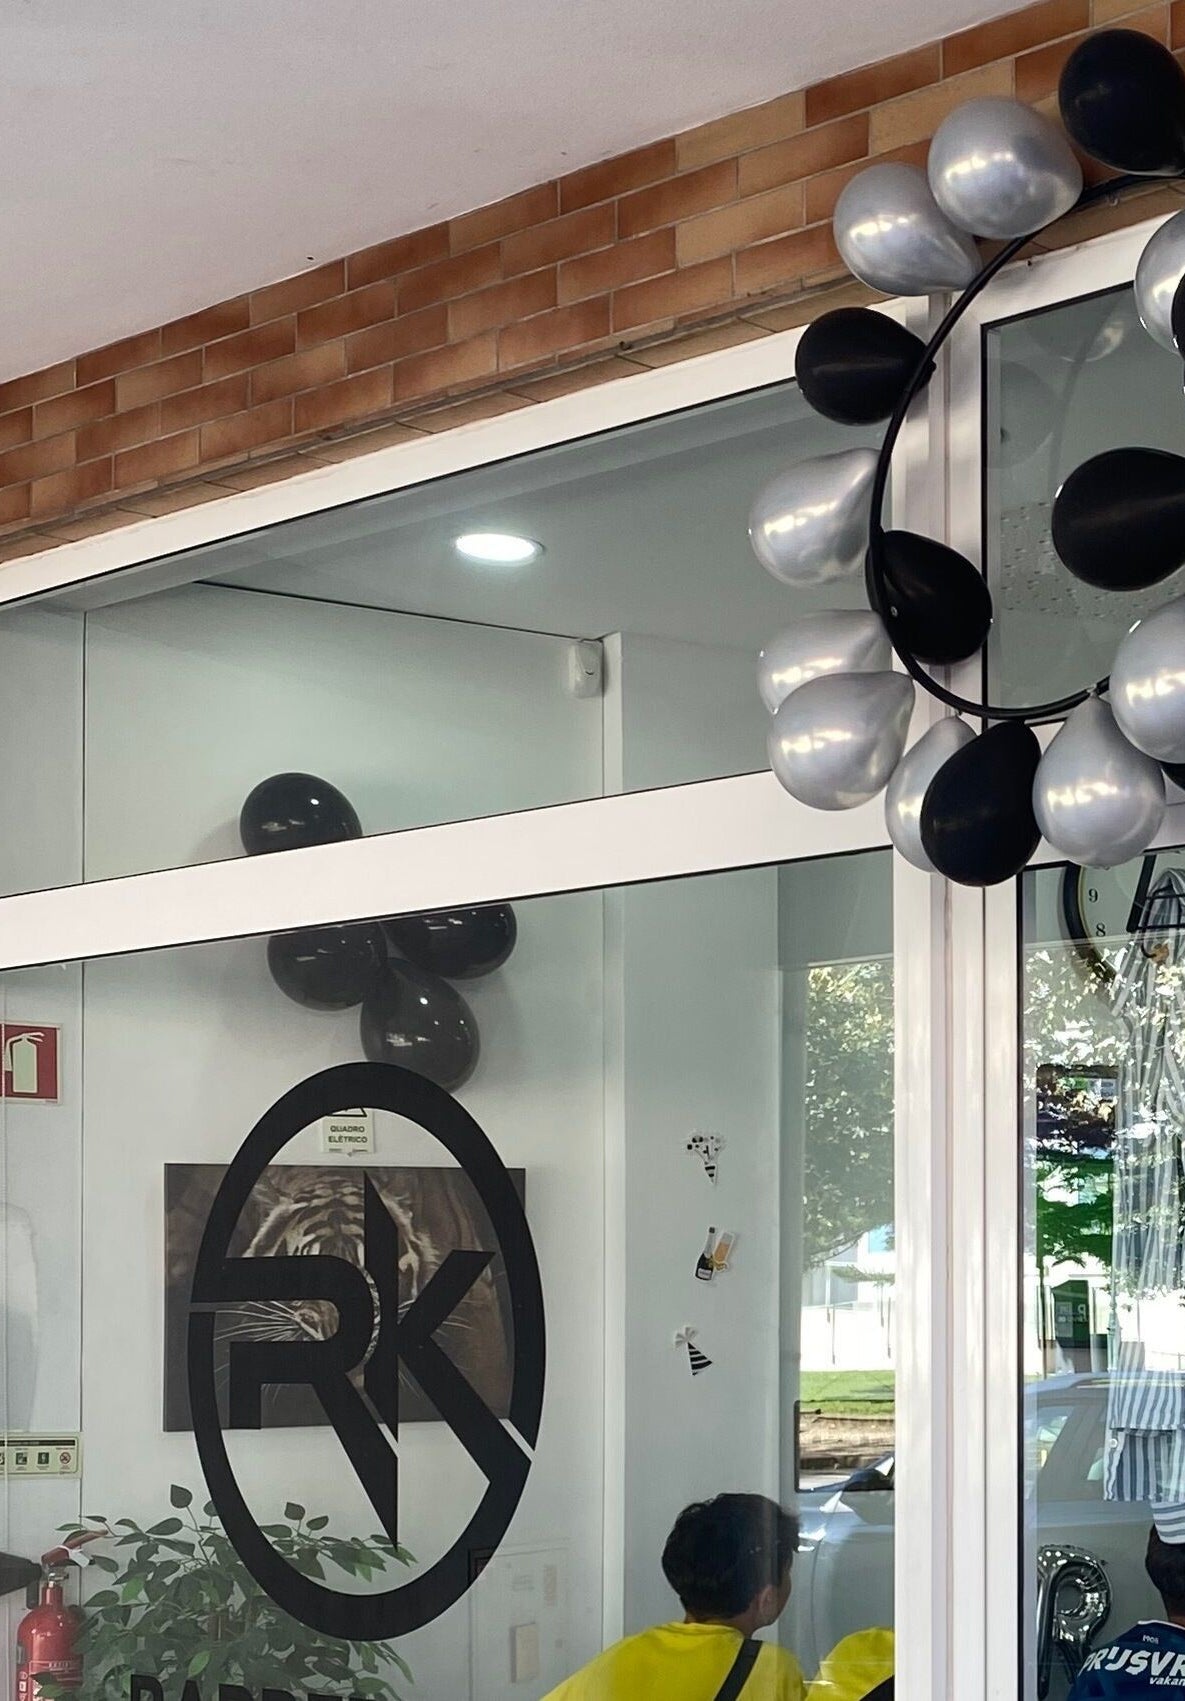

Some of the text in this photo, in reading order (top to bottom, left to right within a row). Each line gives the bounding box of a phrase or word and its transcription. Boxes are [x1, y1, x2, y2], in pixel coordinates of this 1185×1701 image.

[1088, 888, 1099, 903] 9
[1096, 922, 1106, 938] 8
[329, 1125, 366, 1133] QUADRO
[328, 1134, 368, 1143] ELÉTRICO
